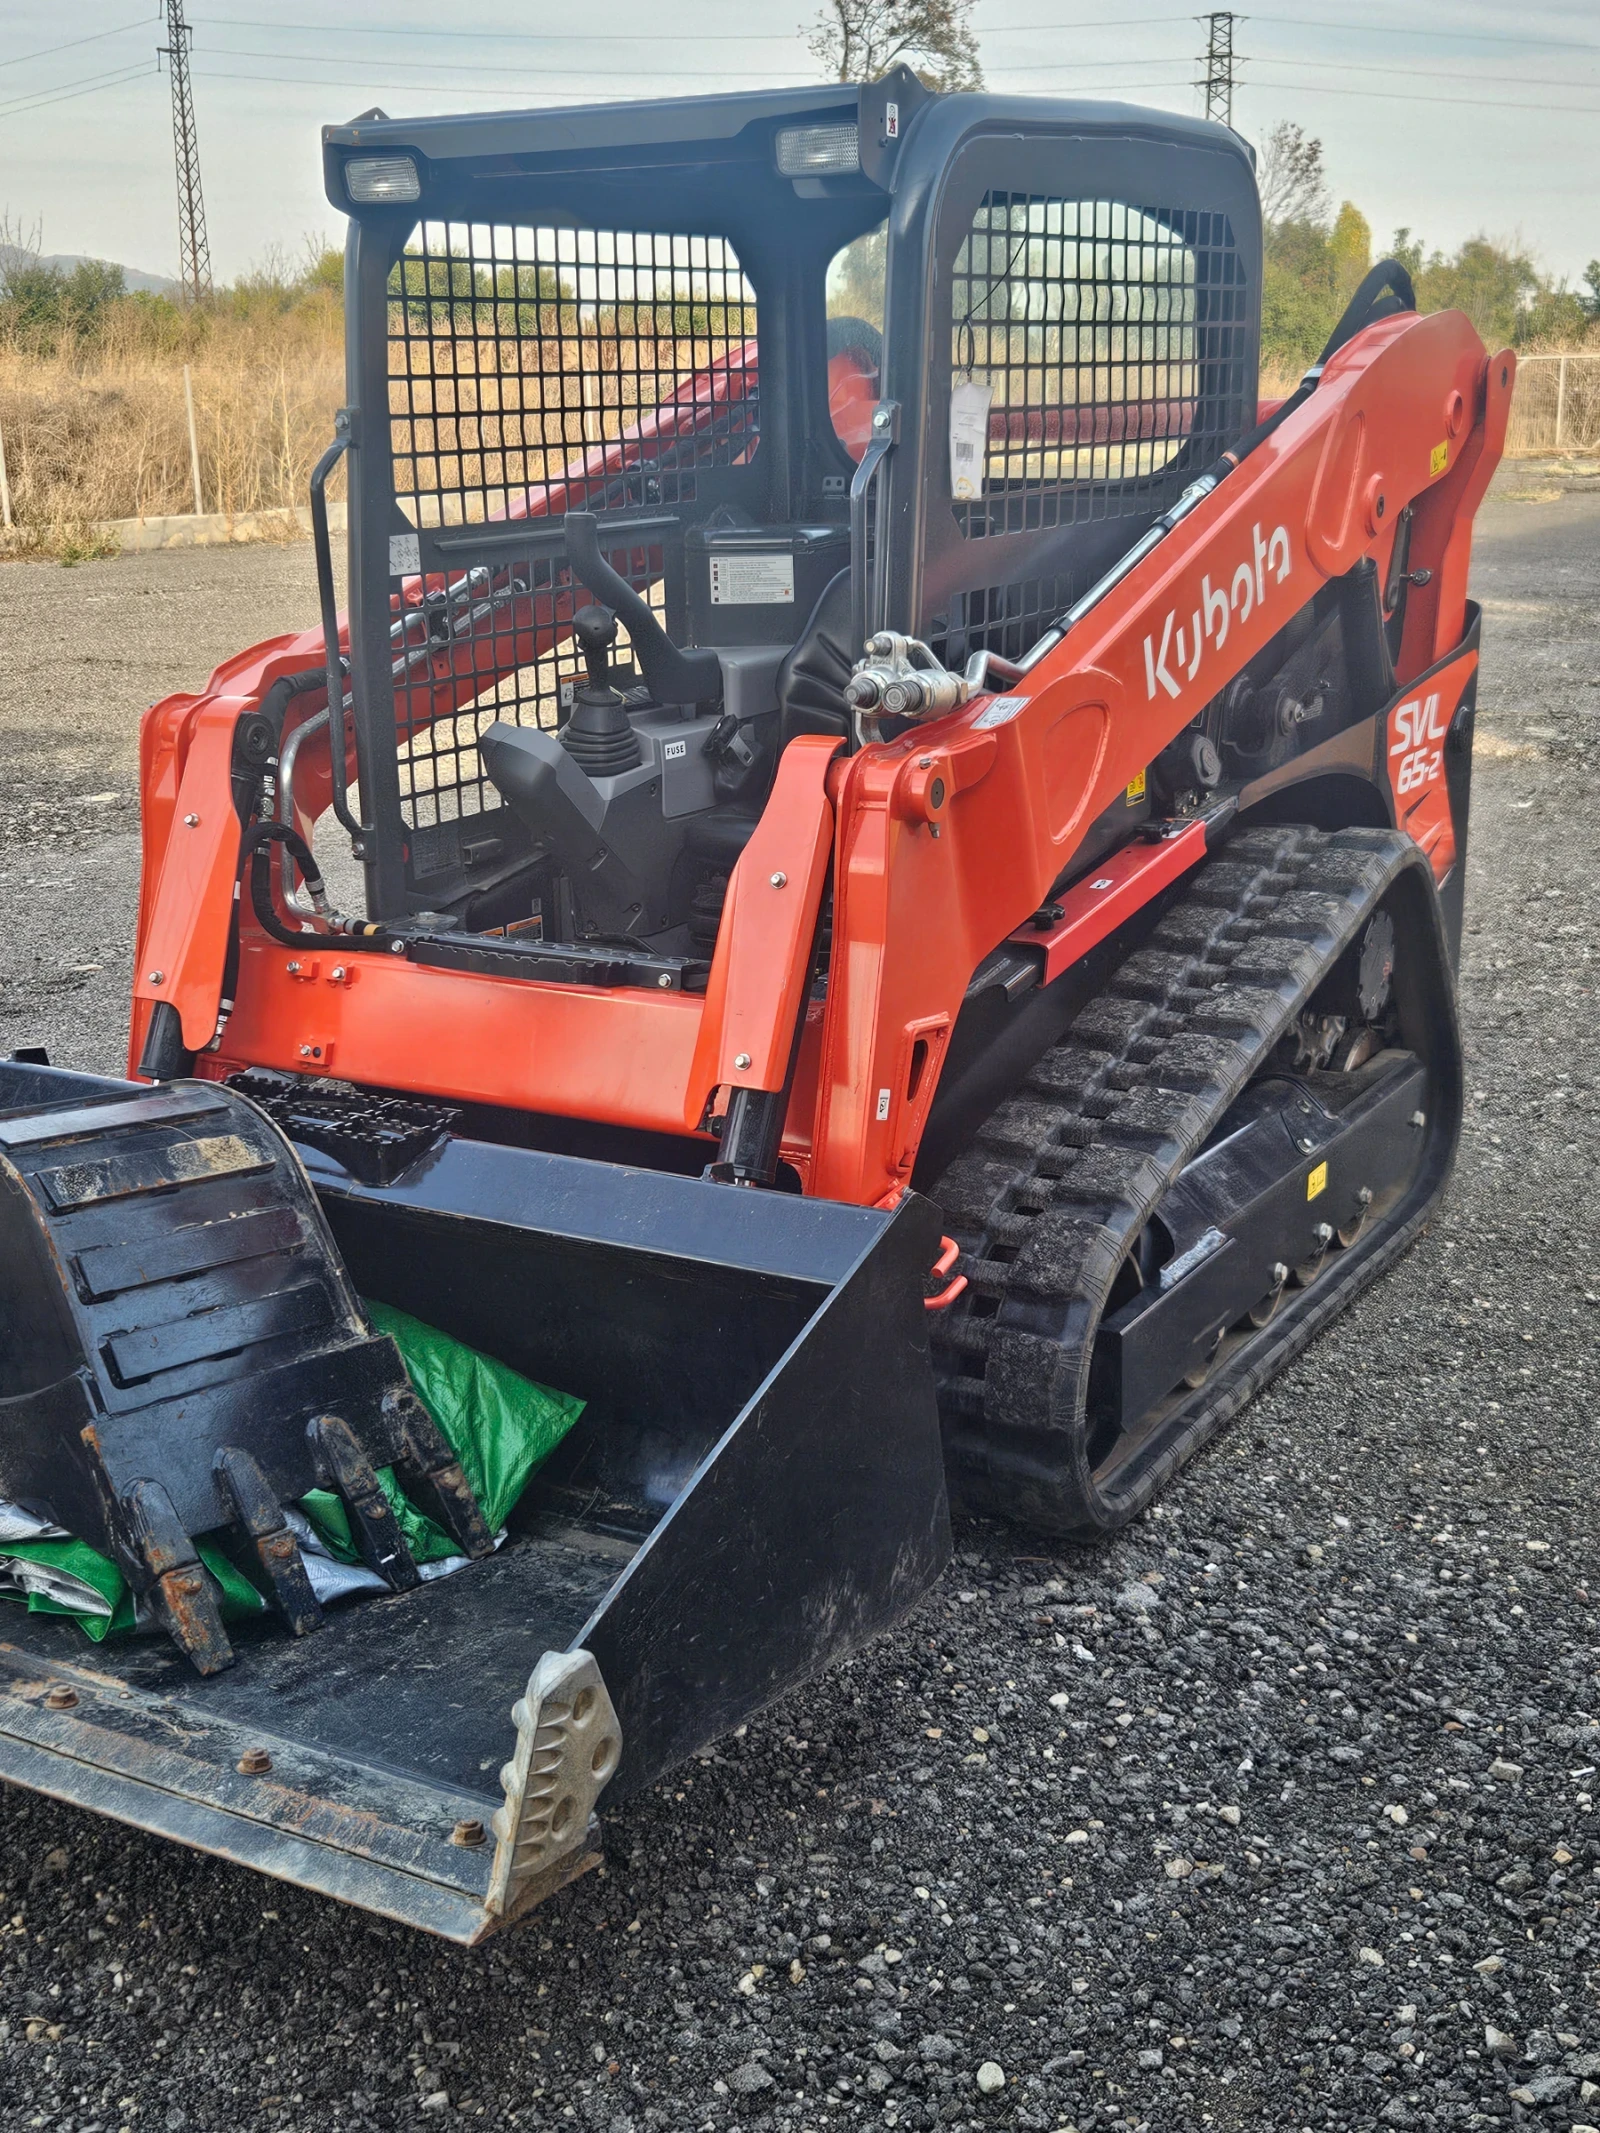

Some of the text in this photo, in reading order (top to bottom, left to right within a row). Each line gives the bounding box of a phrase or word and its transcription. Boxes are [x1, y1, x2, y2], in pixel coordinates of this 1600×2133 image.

[1143, 521, 1292, 701] Kubota
[667, 744, 684, 756] FUSE
[1390, 693, 1444, 756] SVL
[1397, 747, 1440, 794] 65-2
